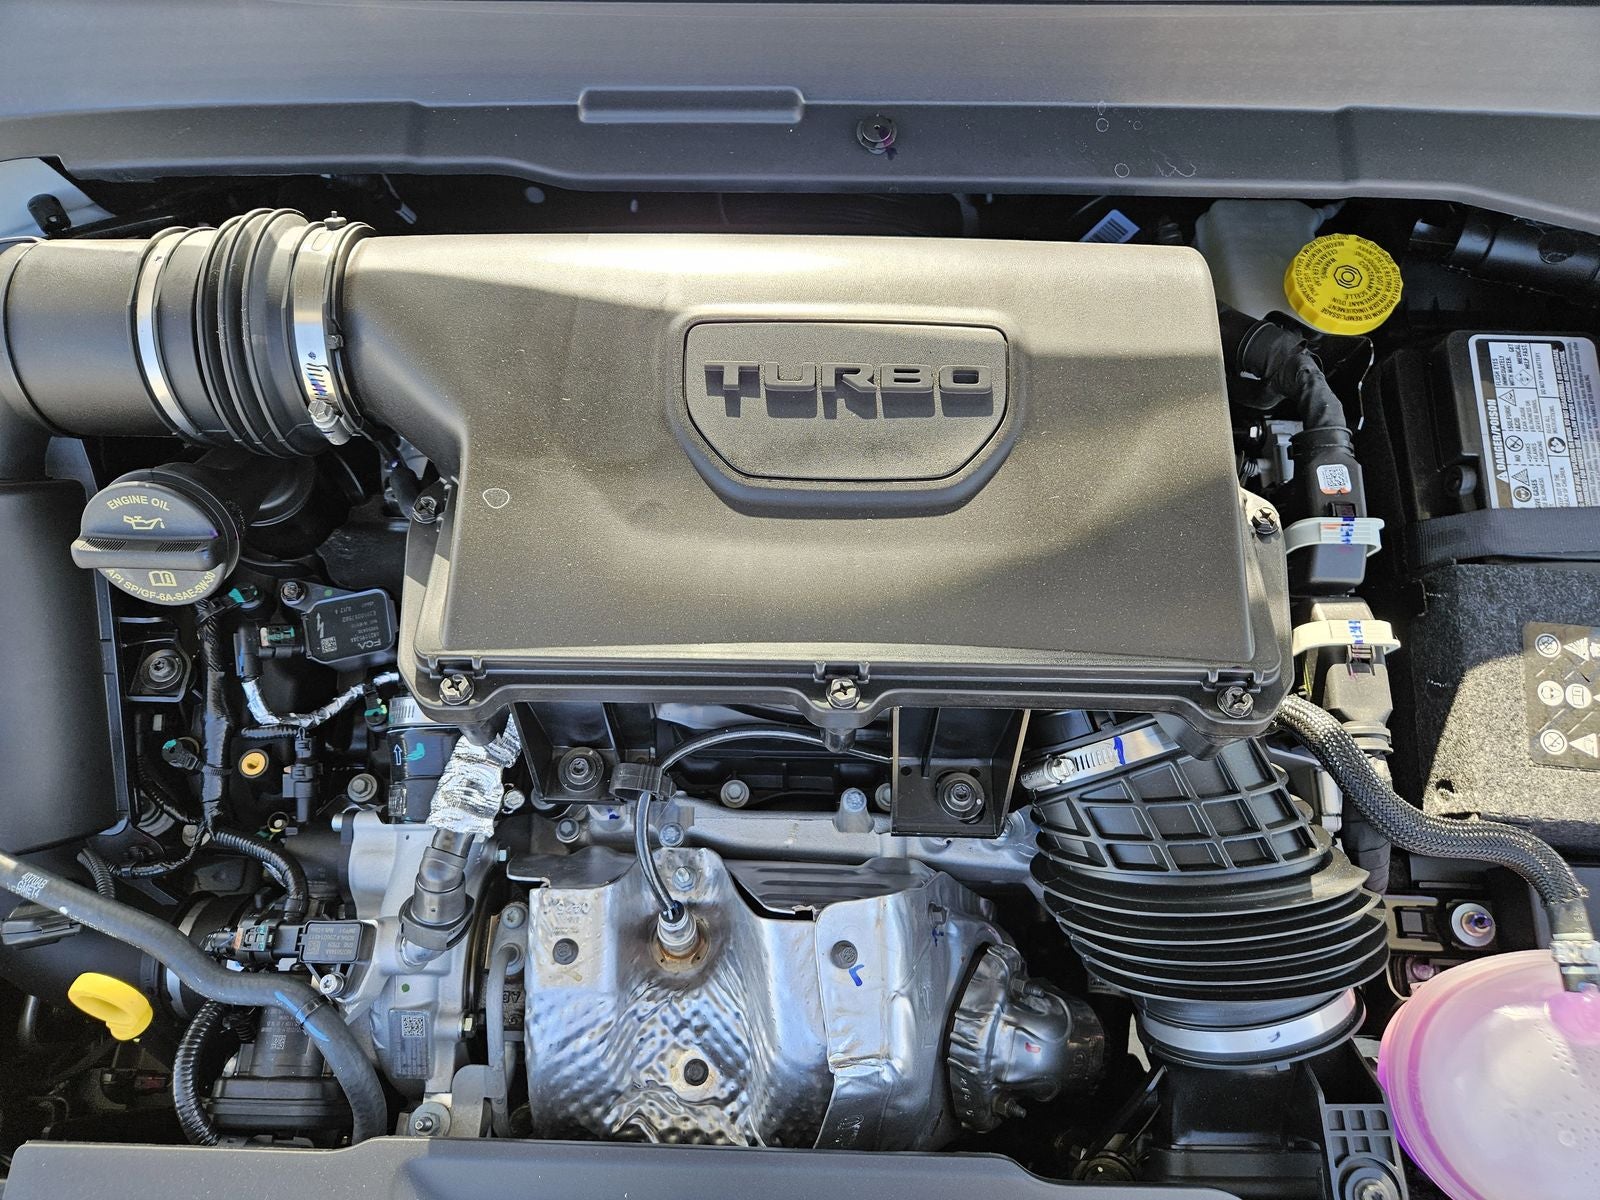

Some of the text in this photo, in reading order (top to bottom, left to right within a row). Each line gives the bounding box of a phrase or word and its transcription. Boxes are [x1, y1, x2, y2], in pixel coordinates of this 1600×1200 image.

[1515, 344, 1523, 364] MEDICAL
[704, 360, 993, 394] TURBO
[1499, 355, 1508, 385] IMMEDIATELY
[1486, 399, 1507, 471] DANGER/POISON
[1515, 454, 1521, 462] NO
[1531, 480, 1539, 496] GASES
[107, 495, 170, 512] ENGINE OIL
[105, 568, 124, 584] API
[357, 638, 382, 650] FCA
